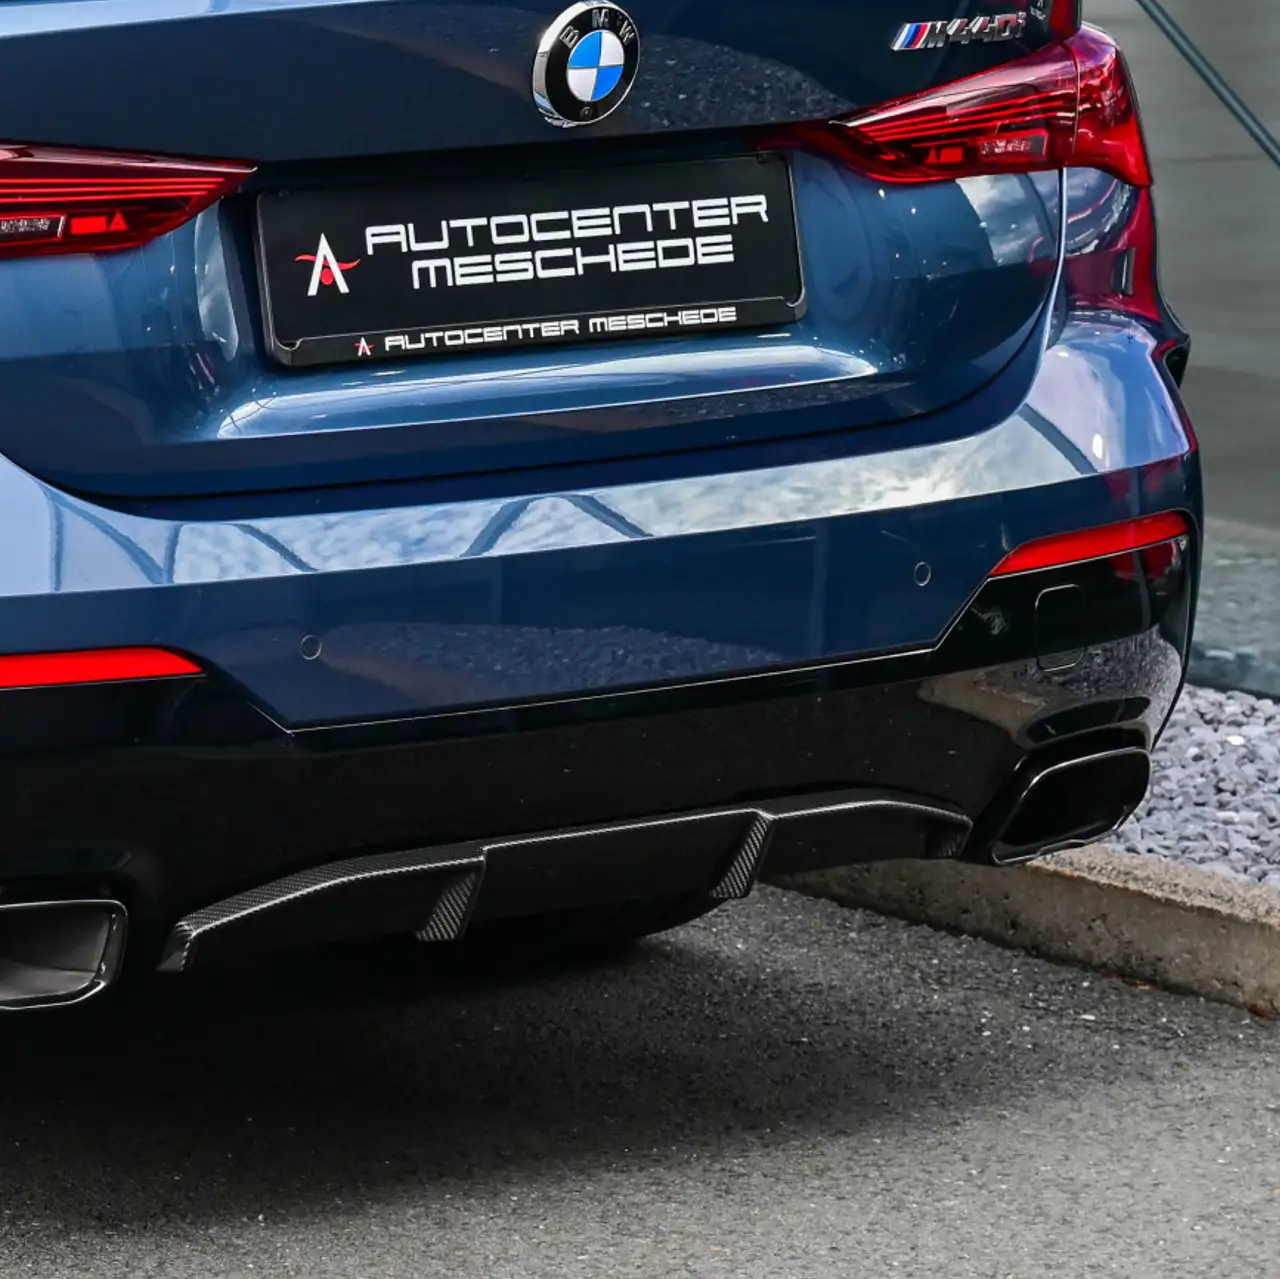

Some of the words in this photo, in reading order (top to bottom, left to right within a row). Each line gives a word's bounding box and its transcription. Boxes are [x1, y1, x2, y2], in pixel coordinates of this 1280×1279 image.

[559, 8, 636, 49] BMW
[920, 10, 1028, 49] M440i
[365, 194, 769, 256] AUTOCENTER
[411, 233, 735, 290] MESCHEDE
[384, 319, 580, 352] AUTOCENTER
[588, 306, 737, 333] MESCHEDE
